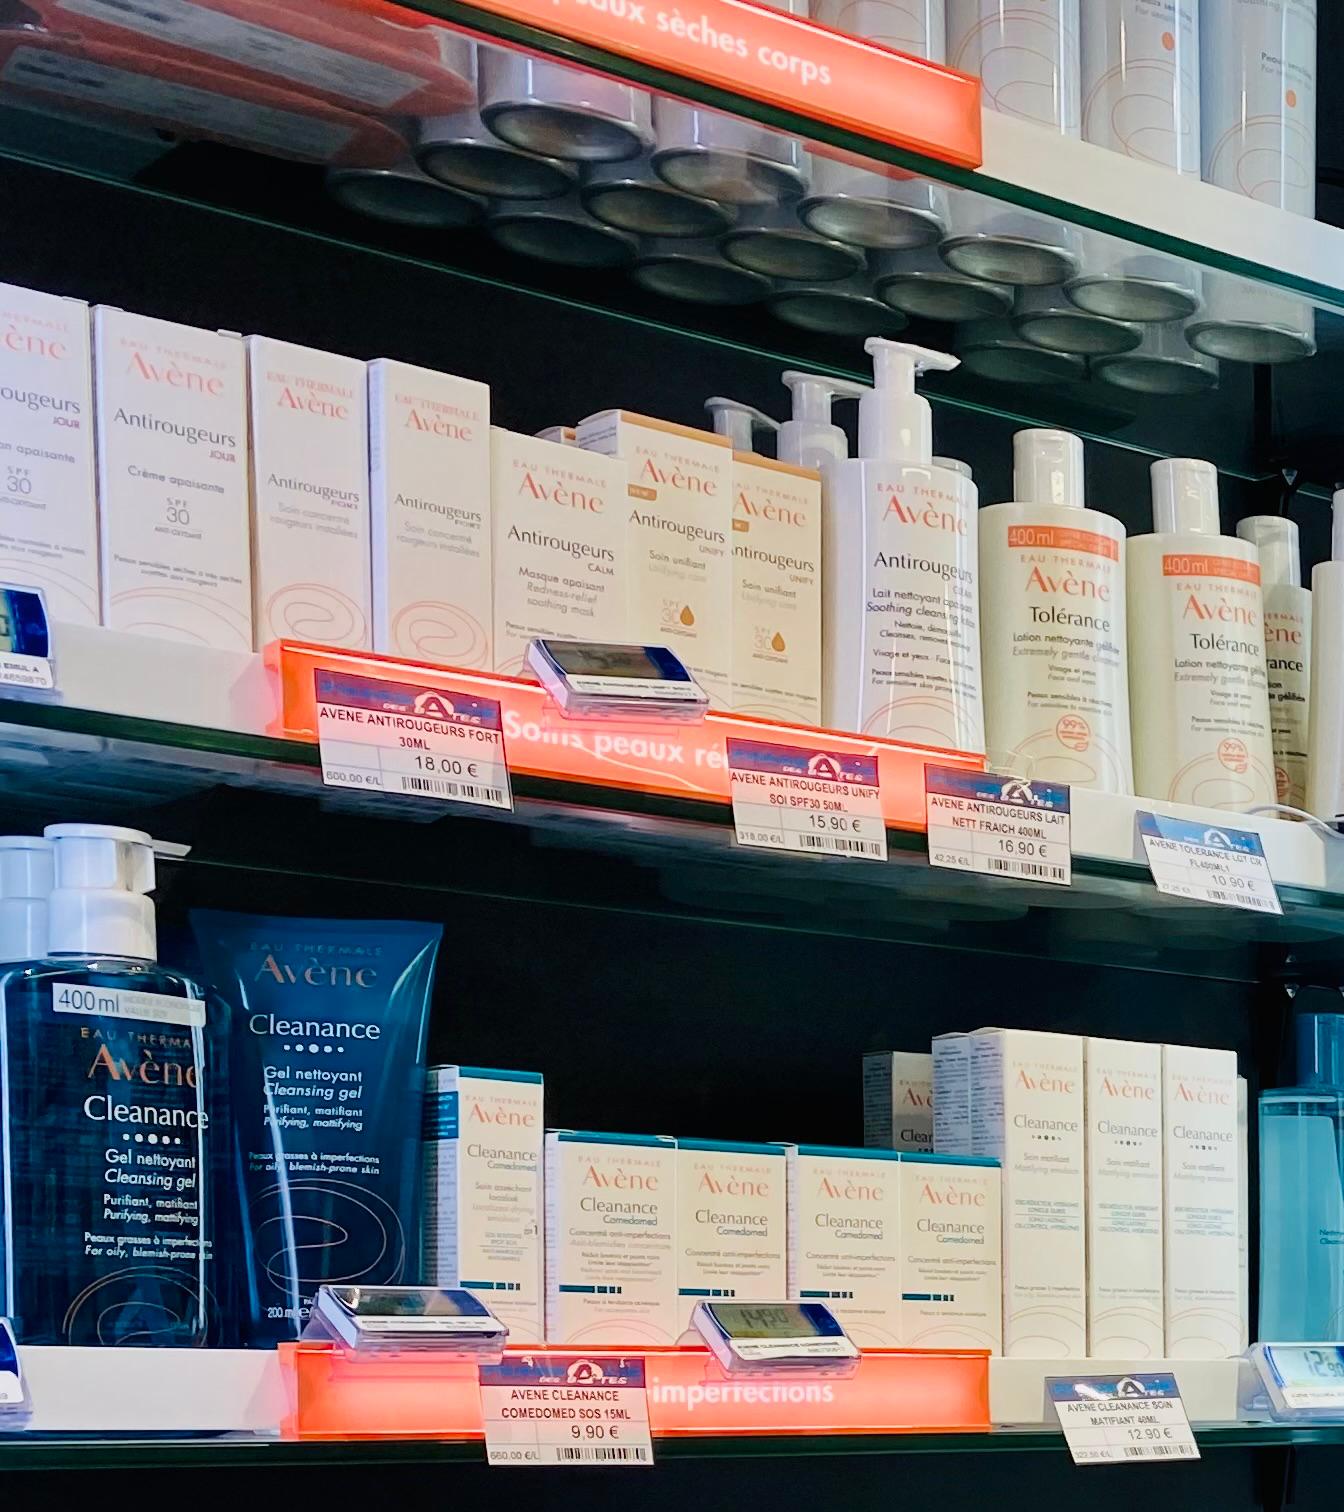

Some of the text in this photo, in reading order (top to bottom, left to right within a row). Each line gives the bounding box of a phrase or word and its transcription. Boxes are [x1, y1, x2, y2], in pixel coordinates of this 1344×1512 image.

[656, 8, 748, 58] sèches
[758, 46, 832, 86] corps
[126, 352, 224, 396] Avène
[277, 387, 348, 420] Avène
[114, 407, 236, 447] Antirougeurs
[406, 408, 473, 442] Avène
[639, 457, 718, 496] Avène
[518, 472, 604, 514] Avène
[166, 506, 190, 525] 30
[394, 493, 481, 523] Antirougeurs
[733, 490, 806, 528] Avène
[883, 494, 968, 536] Avène
[629, 510, 725, 544] Antirougeurs
[507, 525, 615, 562] Antirougeurs
[519, 566, 605, 593] Masque apaisant
[588, 562, 614, 576] CALM
[1025, 567, 1111, 602] Avène
[1029, 605, 1111, 633] Tolérance
[1190, 632, 1259, 657] Tolérance
[320, 707, 500, 744] AVENE ANTIROUGEURS FORT
[399, 736, 431, 751] 30ML
[594, 735, 684, 764] peaux
[466, 762, 478, 778] €
[731, 771, 879, 800] AVENE ANTIROUGEURS UNIFY
[931, 797, 1065, 826] AVENE ANTIROUGEURS LAIT
[851, 818, 861, 833] €
[952, 815, 1047, 840] NETT FRAICH 400ML
[1037, 843, 1047, 859] €
[255, 954, 377, 989] Avène
[248, 1013, 381, 1040] Cleanance
[264, 1065, 362, 1084] Gel nettoyant
[1015, 1068, 1076, 1095] Avène
[263, 1081, 362, 1101] Cleansing gel
[83, 1095, 209, 1129] Cleanance
[468, 1103, 535, 1128] Avène
[1013, 1114, 1079, 1133] Cleanance
[105, 1148, 196, 1170] Gel nettoyant
[466, 1143, 537, 1163] Cleanance
[105, 1169, 196, 1190] Cleansing gel
[580, 1197, 658, 1216] Cleanance
[695, 1210, 768, 1229] Cleanance
[815, 1213, 883, 1231] Cleanance
[511, 1389, 619, 1403] AVENE CLEANANCE
[1067, 1399, 1173, 1413] AVENE CLEANANCE SOIN
[501, 1406, 631, 1421] COMEDOMED SOS 15ML
[1090, 1416, 1160, 1426] MATIFIANT 40ML
[609, 1425, 619, 1440] €
[1163, 1428, 1173, 1440] €
